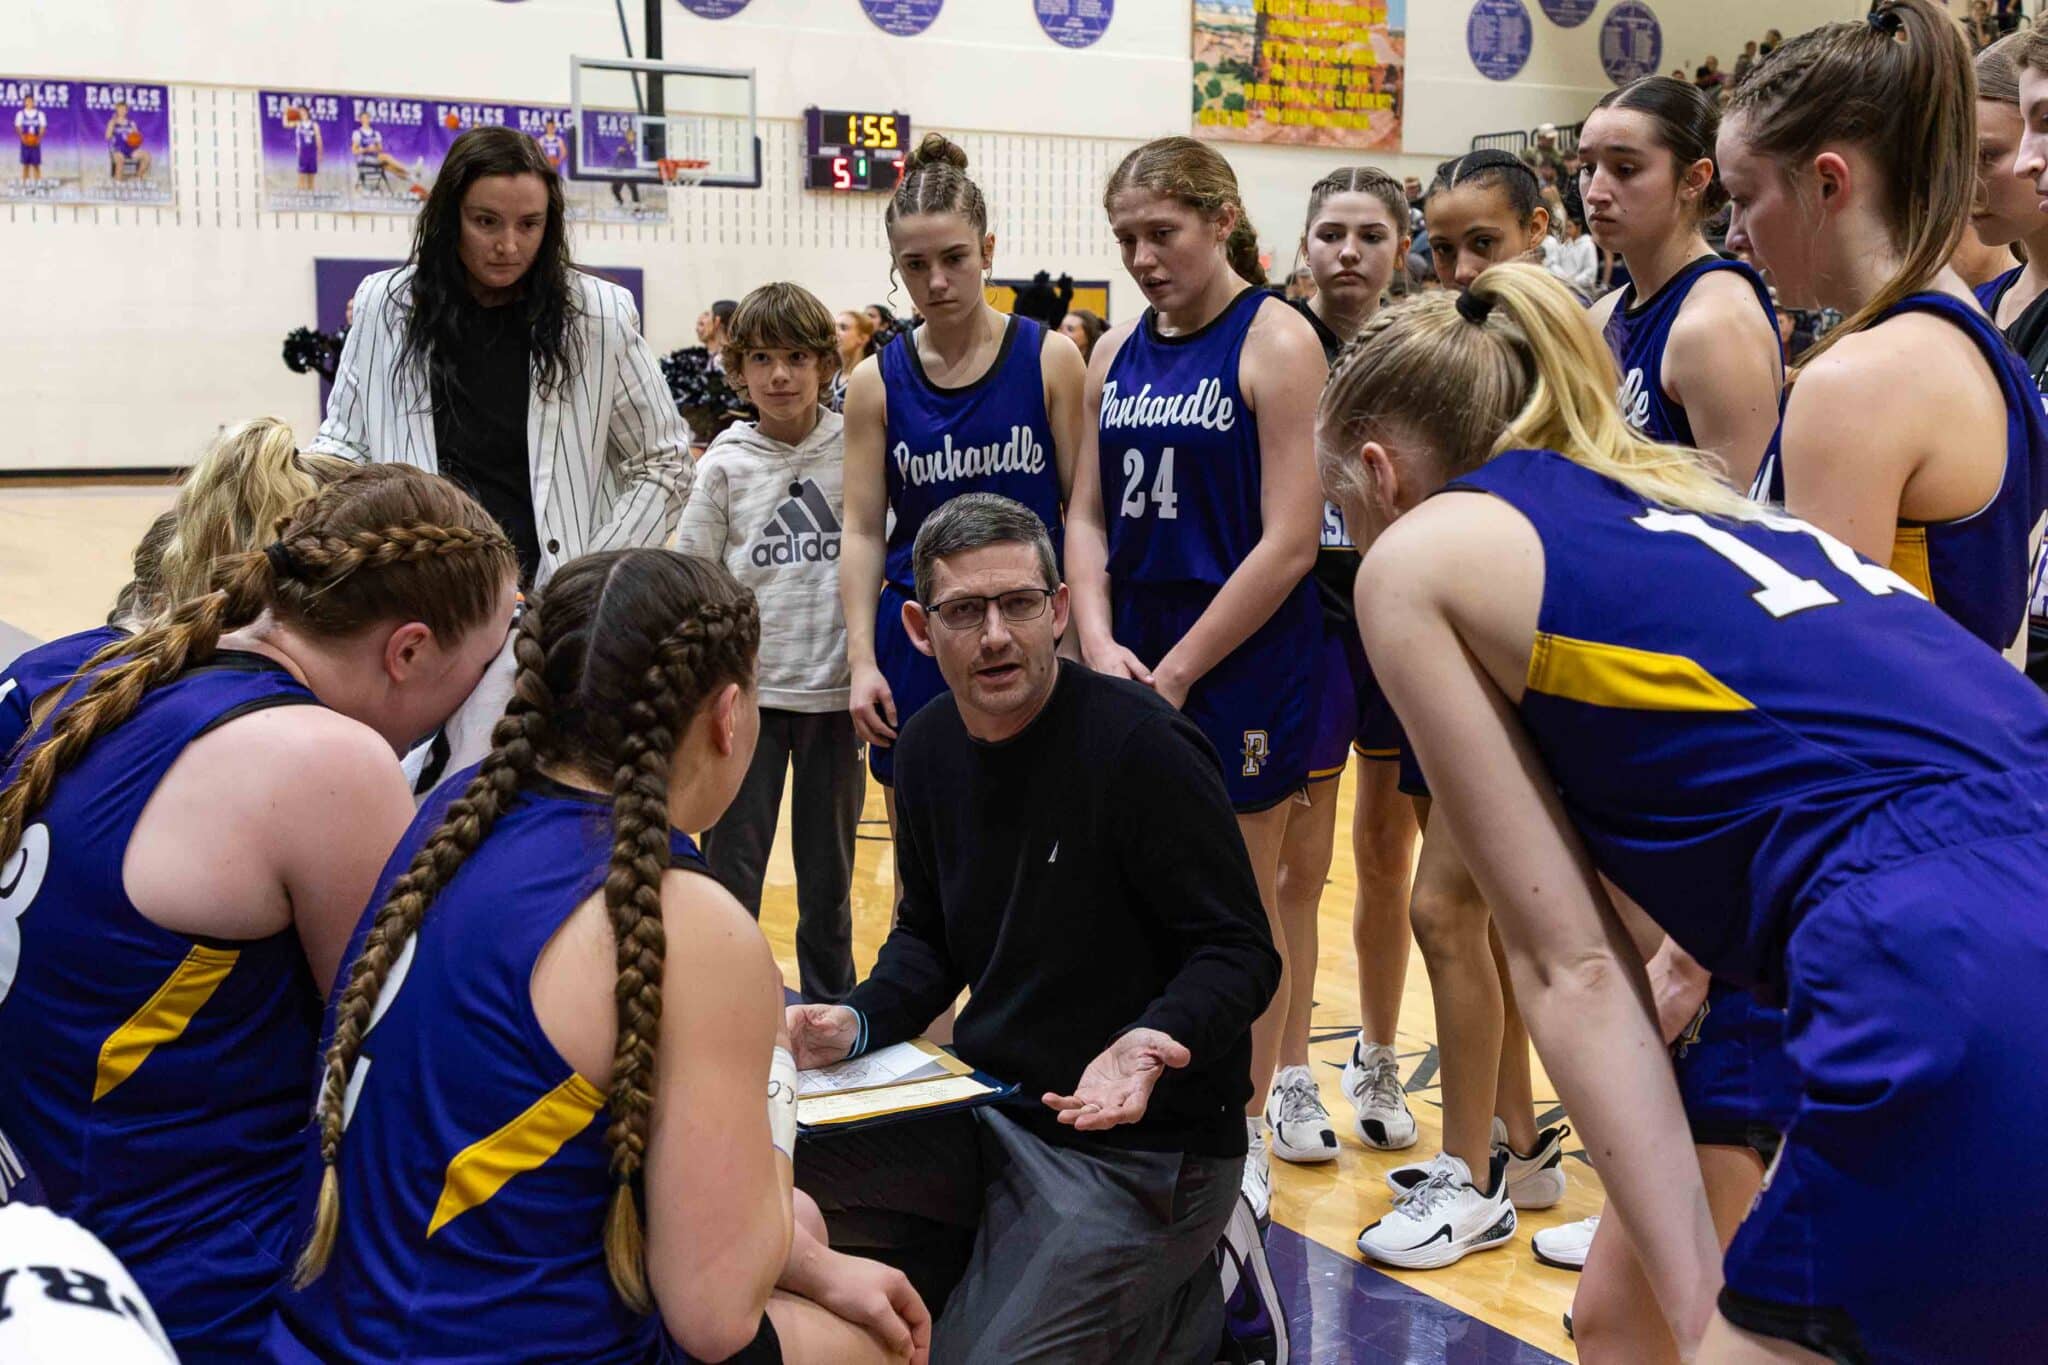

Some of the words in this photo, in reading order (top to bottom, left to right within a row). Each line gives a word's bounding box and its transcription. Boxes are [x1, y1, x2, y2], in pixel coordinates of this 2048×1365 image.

[85, 85, 161, 106] EAGLES
[518, 109, 575, 129] EAGLE
[848, 114, 898, 148] 1:55
[833, 158, 851, 189] 5
[858, 159, 867, 177] 1
[1099, 376, 1237, 432] Panhandle
[892, 424, 1047, 489] Panhandle
[1119, 446, 1179, 520] 24
[751, 531, 842, 568] adida
[1242, 728, 1269, 777] P
